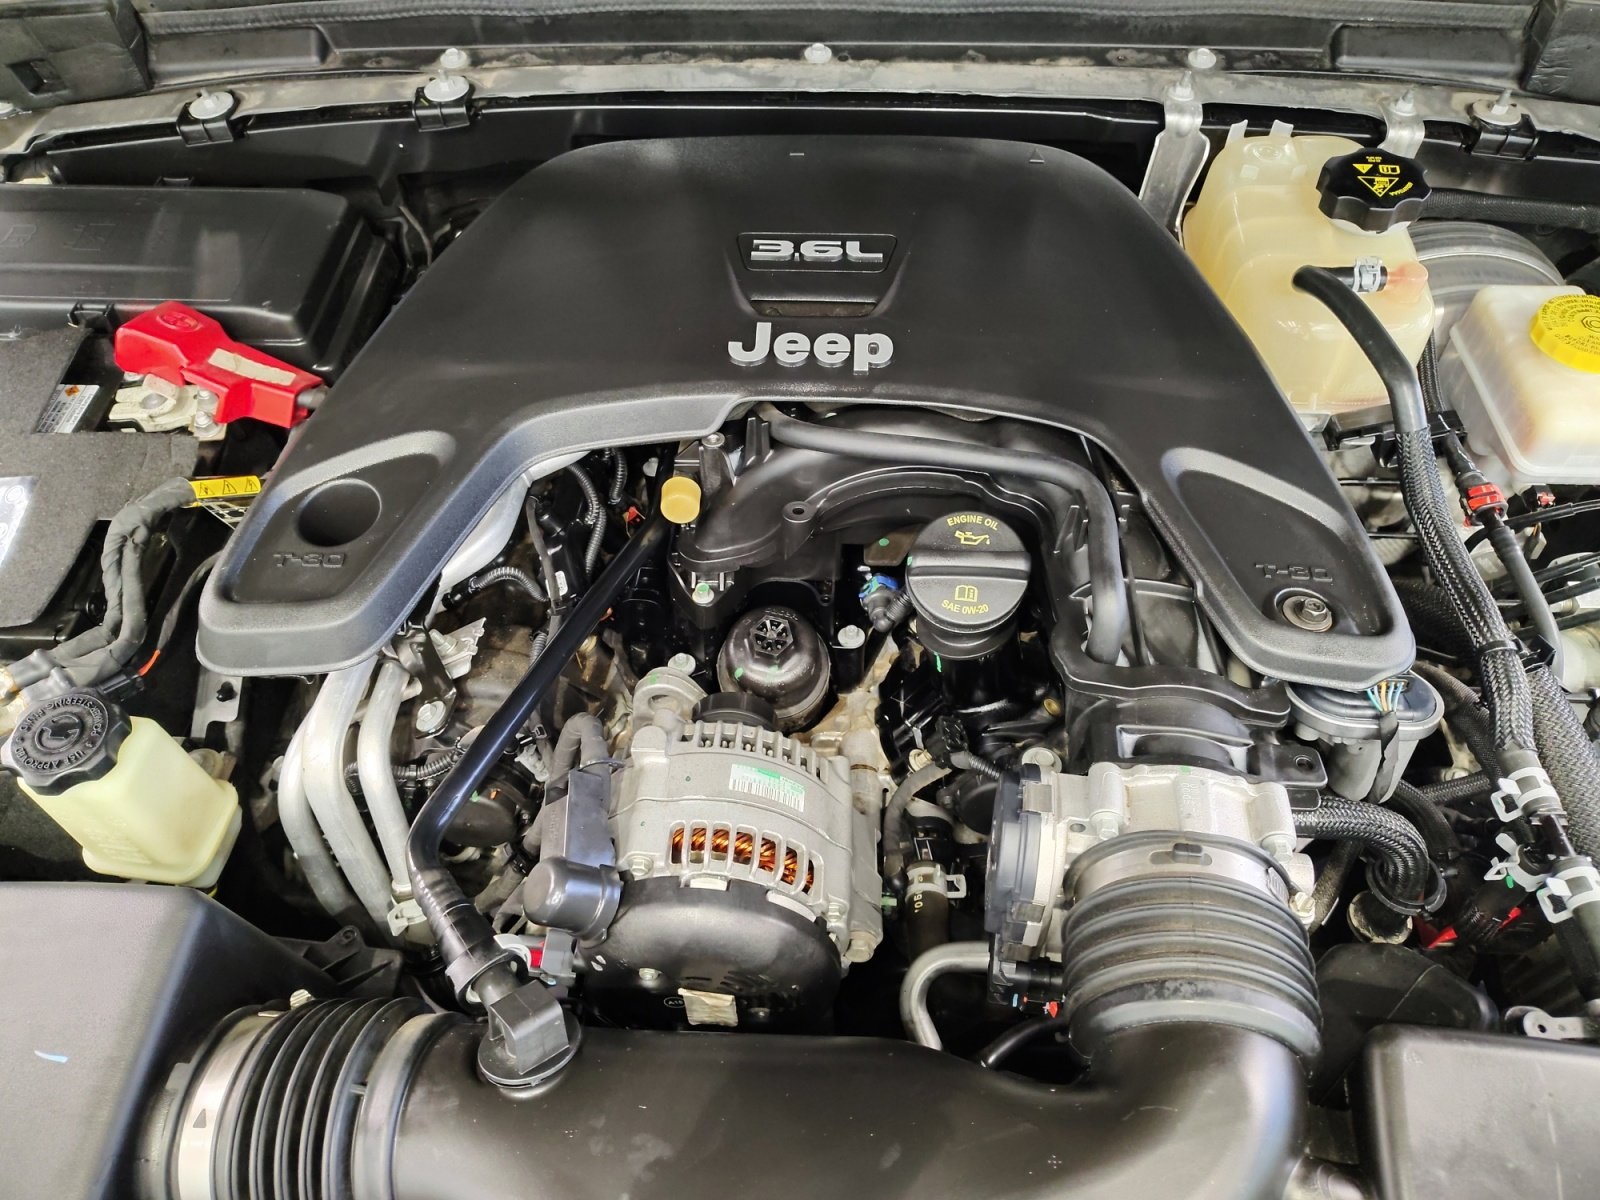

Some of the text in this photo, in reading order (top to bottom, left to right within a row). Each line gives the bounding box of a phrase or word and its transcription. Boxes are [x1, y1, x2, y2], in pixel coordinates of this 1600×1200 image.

[751, 239, 883, 262] 3.6L
[728, 321, 894, 375] Jeep
[946, 514, 999, 531] ENGINE OIL
[273, 553, 345, 568] T-30
[1255, 563, 1333, 583] T-30
[942, 599, 989, 614] SAE 0W-20
[45, 697, 93, 710] STEERING
[15, 746, 86, 770] USE APPROVED
